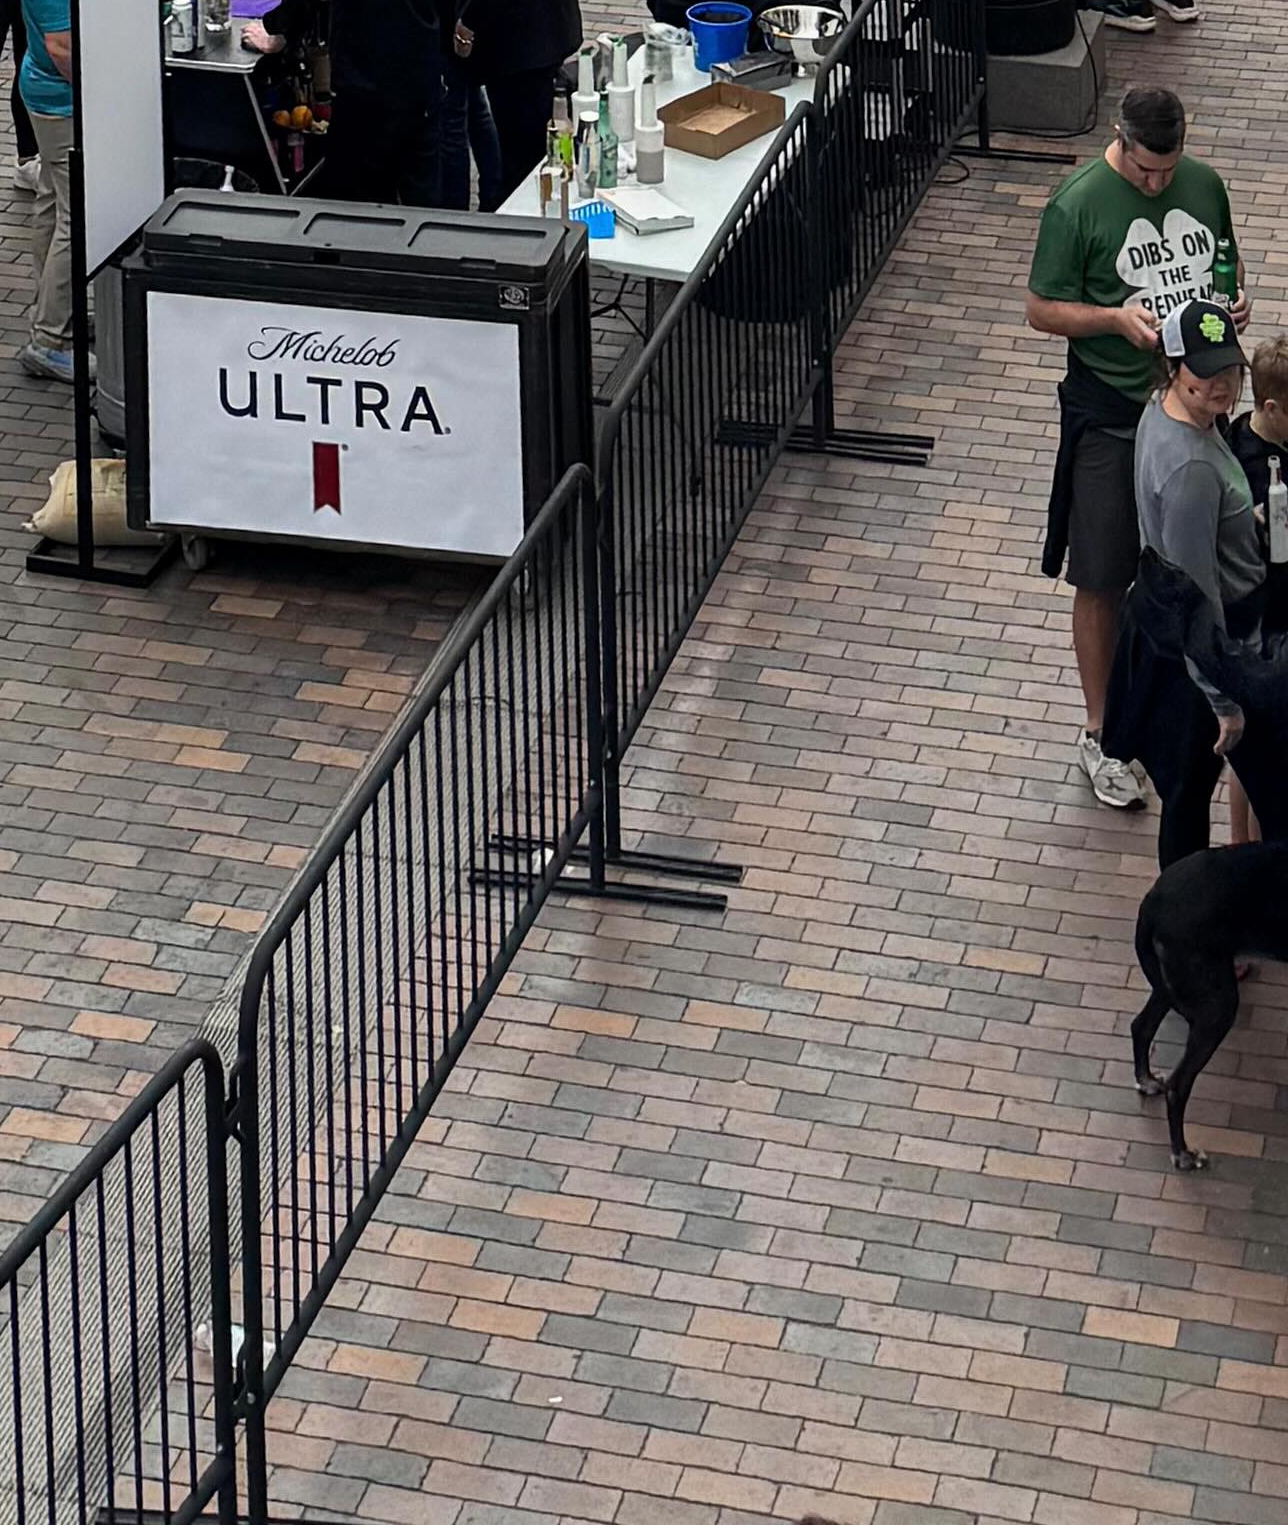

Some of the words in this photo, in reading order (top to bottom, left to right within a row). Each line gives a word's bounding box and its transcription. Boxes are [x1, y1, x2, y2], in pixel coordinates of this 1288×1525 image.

[1128, 238, 1175, 270] DIBS
[1182, 229, 1210, 257] ON
[1158, 265, 1192, 287] THE
[248, 326, 401, 368] Michelob
[219, 367, 445, 435] ULTRA
